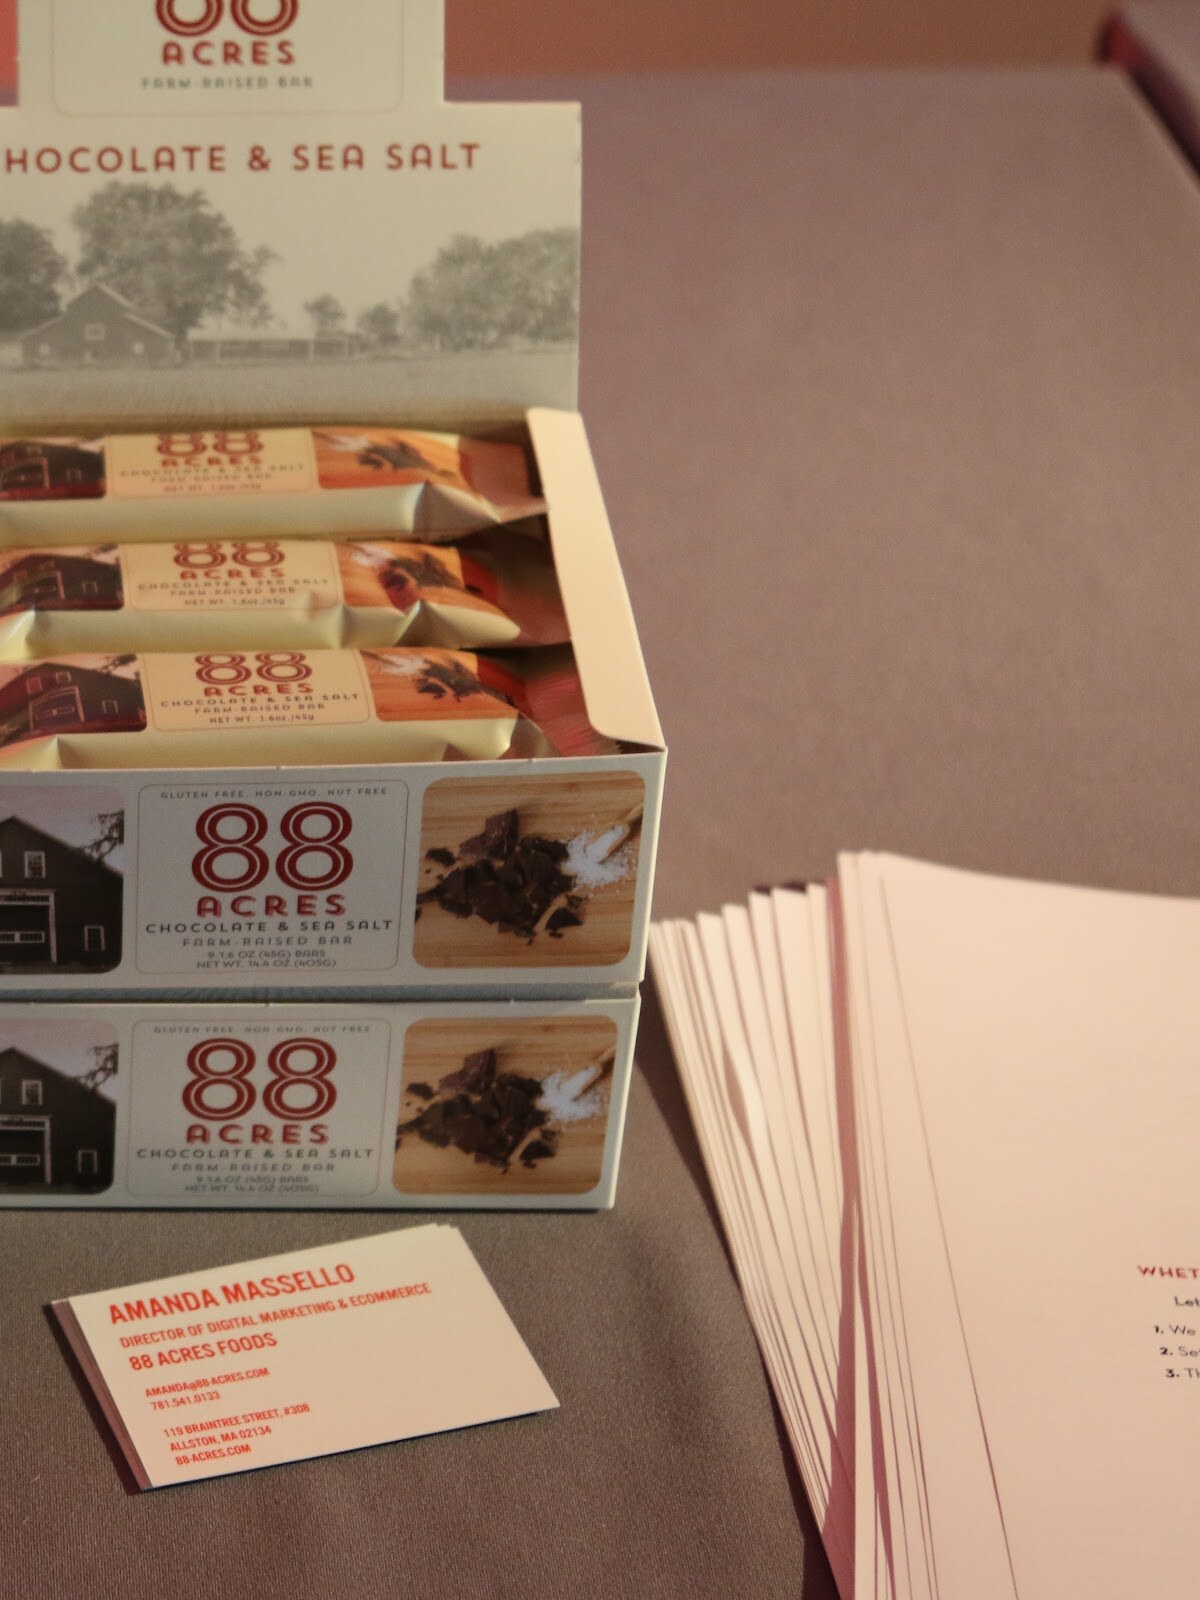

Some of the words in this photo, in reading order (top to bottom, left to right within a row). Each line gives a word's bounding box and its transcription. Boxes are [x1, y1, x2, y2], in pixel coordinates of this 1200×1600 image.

[162, 40, 296, 66] ACRES
[278, 76, 314, 89] BAR
[247, 146, 272, 173] &
[292, 144, 365, 172] SEA
[386, 142, 481, 171] SALT
[173, 542, 286, 569] 88
[180, 569, 284, 580] ACRES
[194, 652, 312, 685] 88
[204, 683, 314, 697] ACRES
[160, 697, 256, 708] CHOCOLATE
[285, 695, 313, 703] SEA
[323, 694, 359, 702] SALT
[298, 702, 326, 710] BAR
[210, 716, 231, 724] NET
[161, 792, 208, 800] GLUTEN
[328, 788, 352, 796] NUT
[358, 787, 386, 796] FREE
[192, 801, 354, 892] 88
[196, 894, 346, 918] ACRES
[146, 922, 266, 934] CHOCOLATE
[278, 921, 290, 932] &
[300, 920, 336, 932] SEA
[346, 920, 392, 931] SALT
[318, 936, 353, 946] BAR
[197, 960, 220, 968] NET
[274, 958, 290, 966] OZ
[238, 950, 255, 958] OZ
[259, 950, 291, 960] (45G)
[295, 949, 326, 958] BARS
[182, 1037, 337, 1122] 88
[186, 1124, 330, 1144] ACRES
[137, 1149, 252, 1159] CHOCOLATE
[264, 1149, 275, 1159] &
[285, 1149, 319, 1158] SEA
[330, 1148, 374, 1158] SALT
[302, 1163, 336, 1172] BAR
[109, 1288, 220, 1325] AMANDA
[221, 1263, 356, 1304] MASSELLO
[120, 1327, 185, 1349] DIRECTOR
[188, 1323, 204, 1337] OF
[206, 1314, 259, 1334] DIGITAL
[260, 1300, 336, 1324] MARKETING
[338, 1298, 349, 1311] &
[350, 1282, 432, 1307] ECOMMERCE
[1154, 1325, 1164, 1334] 1.
[1169, 1324, 1196, 1336] We
[129, 1354, 154, 1371] 88
[158, 1343, 216, 1367] ACRES
[218, 1332, 278, 1354] FOODS
[1160, 1346, 1174, 1356] 2.
[1166, 1368, 1180, 1378] 3.
[145, 1367, 270, 1398] AMANDA@88-ACRES.COM
[150, 1391, 220, 1411] 781.541.0133
[164, 1427, 184, 1438] 119
[185, 1417, 242, 1434] BRAINTREE
[242, 1408, 284, 1424] STREET,
[170, 1436, 220, 1452] ALLSTON,
[221, 1430, 238, 1442] MA
[239, 1425, 272, 1440] 02134
[175, 1444, 252, 1466] 88-ACRES.COM
